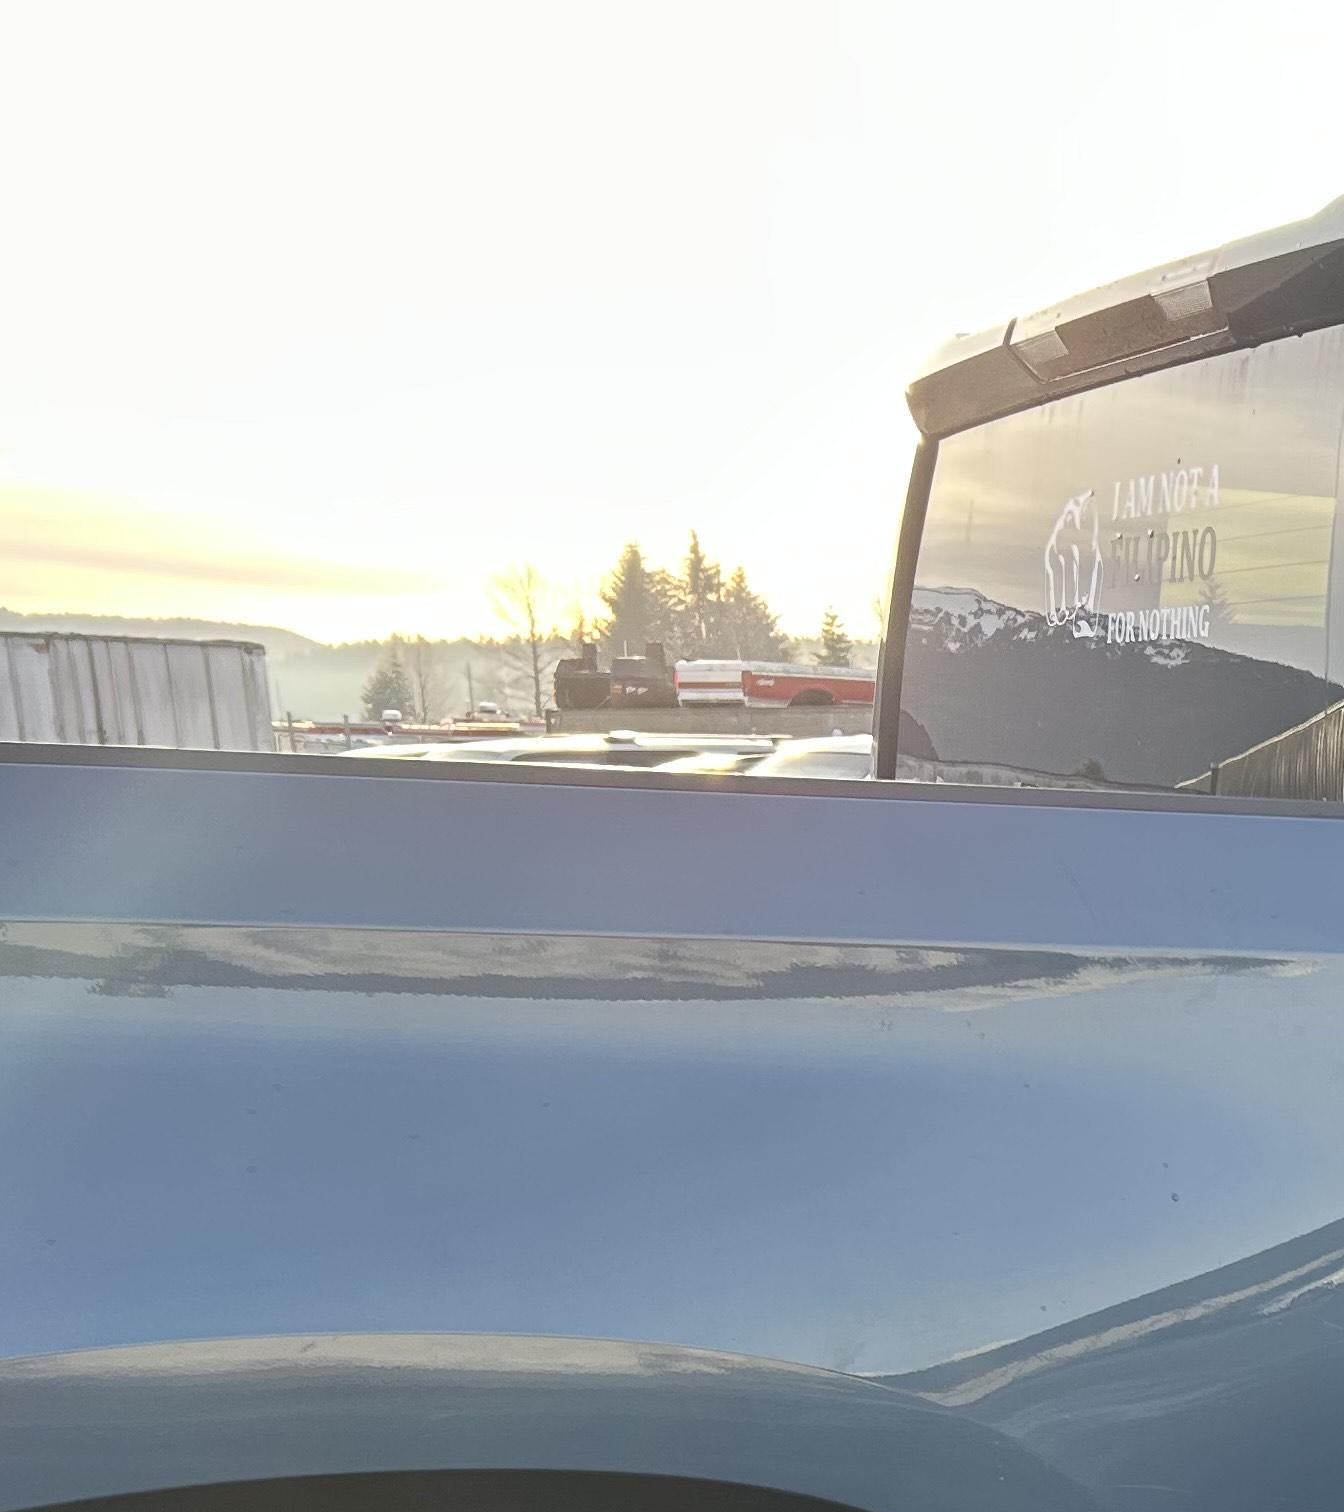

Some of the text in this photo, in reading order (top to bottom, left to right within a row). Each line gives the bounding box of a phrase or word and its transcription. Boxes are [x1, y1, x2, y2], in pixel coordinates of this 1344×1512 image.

[1123, 474, 1155, 519] AM
[1157, 467, 1203, 514] NOT
[1208, 464, 1221, 506] A
[1110, 526, 1217, 589] FILIPINO
[1107, 605, 1210, 644] FOR NOTHING
